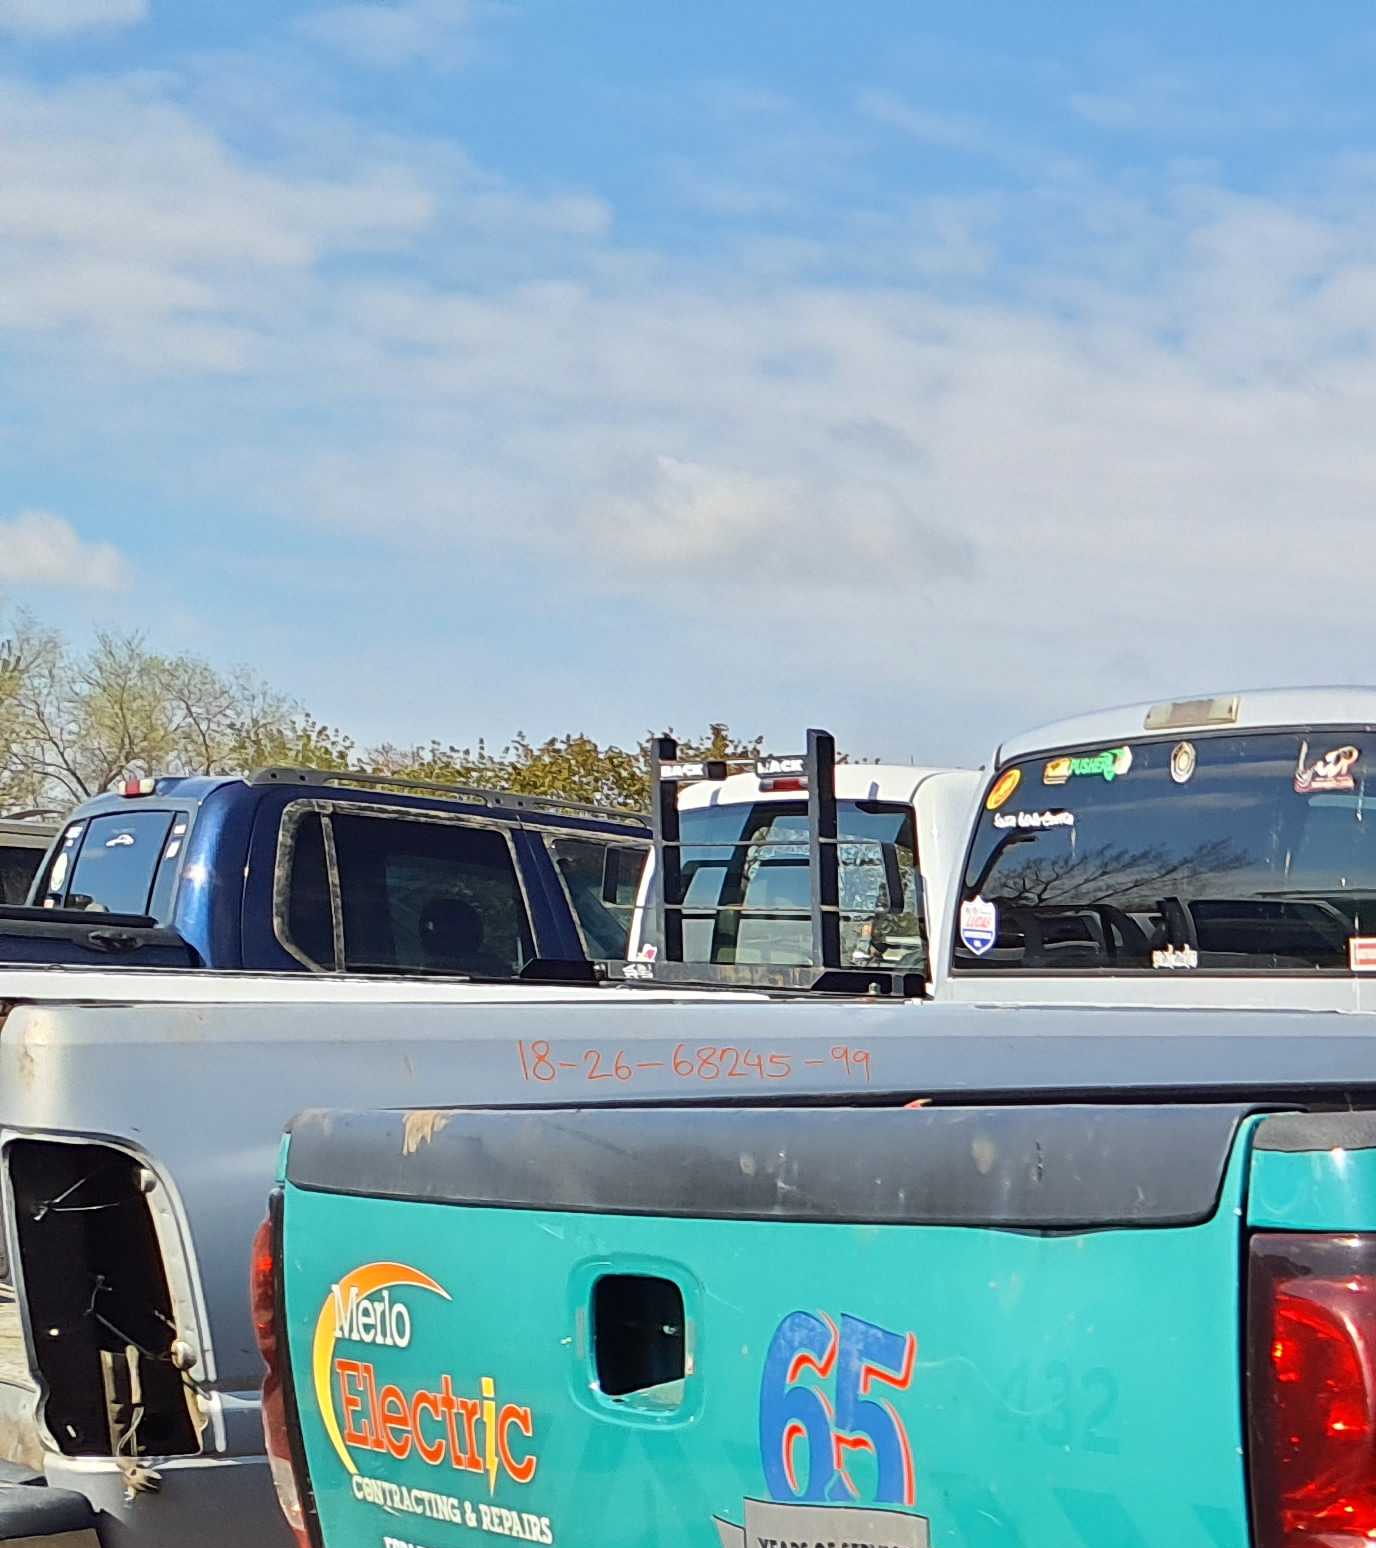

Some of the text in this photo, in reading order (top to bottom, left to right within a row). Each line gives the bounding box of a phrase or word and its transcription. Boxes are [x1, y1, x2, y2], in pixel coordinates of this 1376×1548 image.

[331, 1284, 411, 1348] Merlo
[335, 1359, 537, 1496] Electric
[758, 1308, 918, 1507] 65
[352, 1475, 553, 1545] CONTRACTING & REPAIRS
